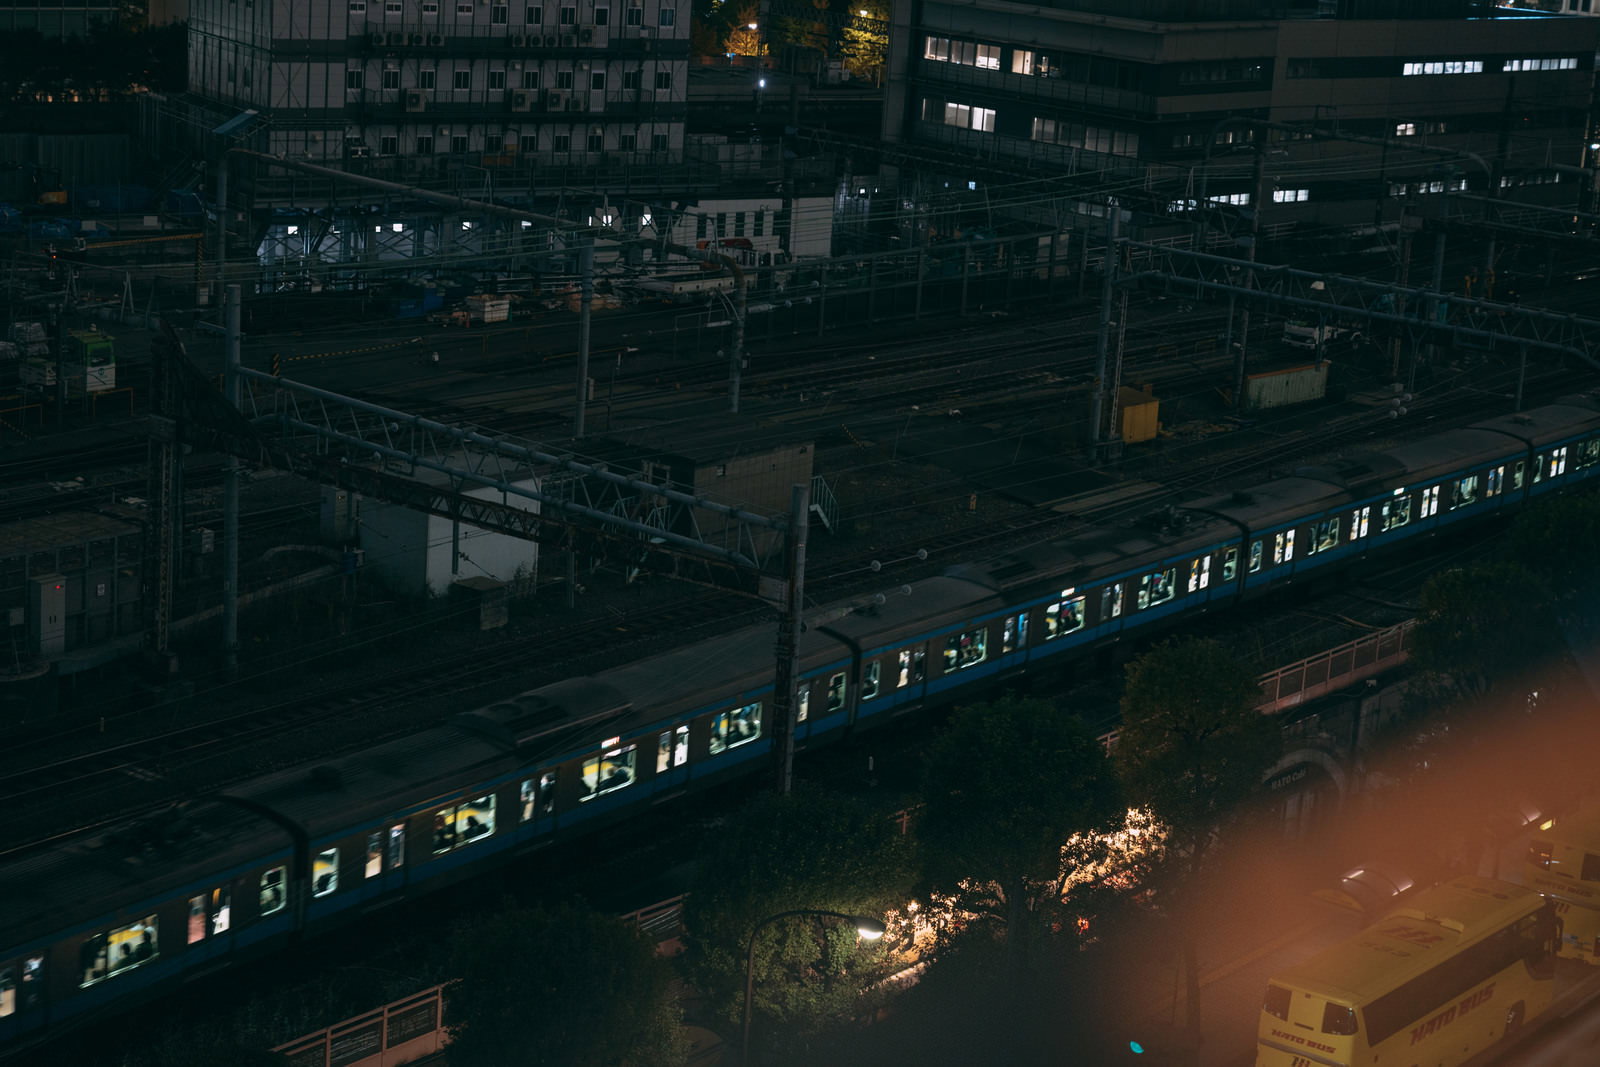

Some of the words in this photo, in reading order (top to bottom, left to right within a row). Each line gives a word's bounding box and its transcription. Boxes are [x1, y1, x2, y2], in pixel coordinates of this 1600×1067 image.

[1409, 1006, 1457, 1046] HATO
[1459, 981, 1496, 1016] BUS
[1272, 1029, 1304, 1044] HATO
[1307, 1040, 1336, 1053] BUS
